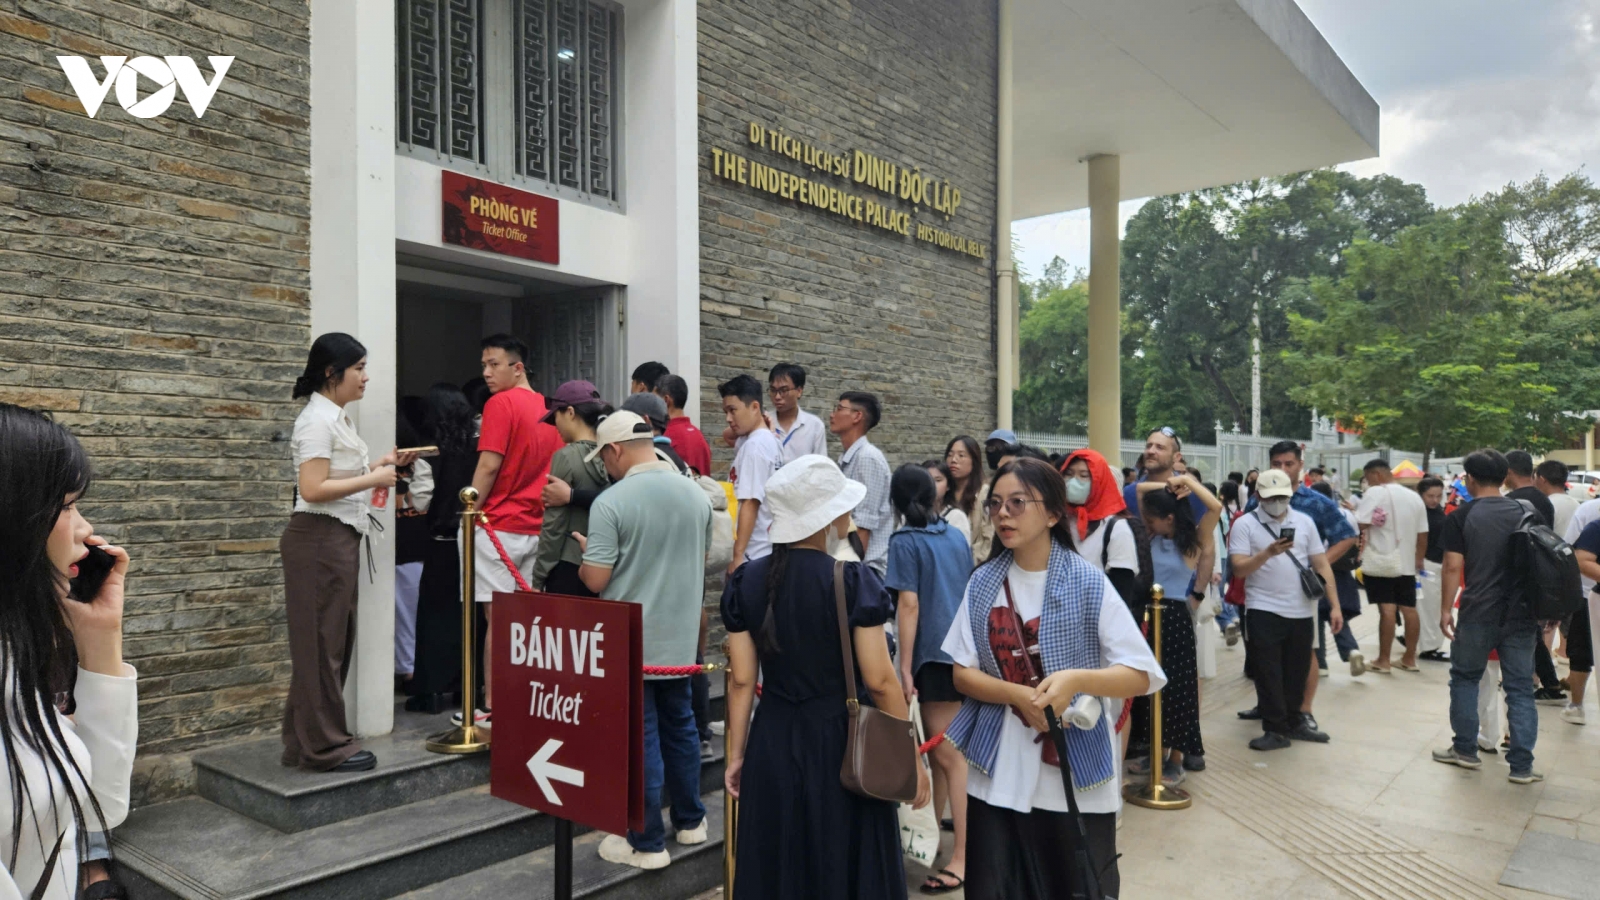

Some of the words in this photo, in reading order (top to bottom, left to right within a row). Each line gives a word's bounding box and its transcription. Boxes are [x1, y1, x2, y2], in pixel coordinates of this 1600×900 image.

[750, 122, 765, 148] DI
[769, 127, 801, 161] TÍCH
[804, 145, 832, 172] LỊCH
[834, 151, 850, 178] SỬ
[854, 150, 896, 195] DINH
[900, 165, 931, 213] ĐỘC
[934, 178, 961, 221] LẬP
[470, 195, 518, 225] PHÒNG
[521, 207, 538, 229] VÉ
[711, 147, 747, 185] THE
[751, 161, 863, 222] INDEPENDENCE
[866, 201, 910, 236] PALACE
[917, 223, 967, 253] HISTORICAL
[967, 240, 987, 259] RELIC
[482, 221, 504, 237] Ticket
[505, 227, 528, 243] Office
[510, 616, 563, 672] BÁN
[569, 622, 605, 678] VÉ
[529, 680, 583, 725] Ticket
